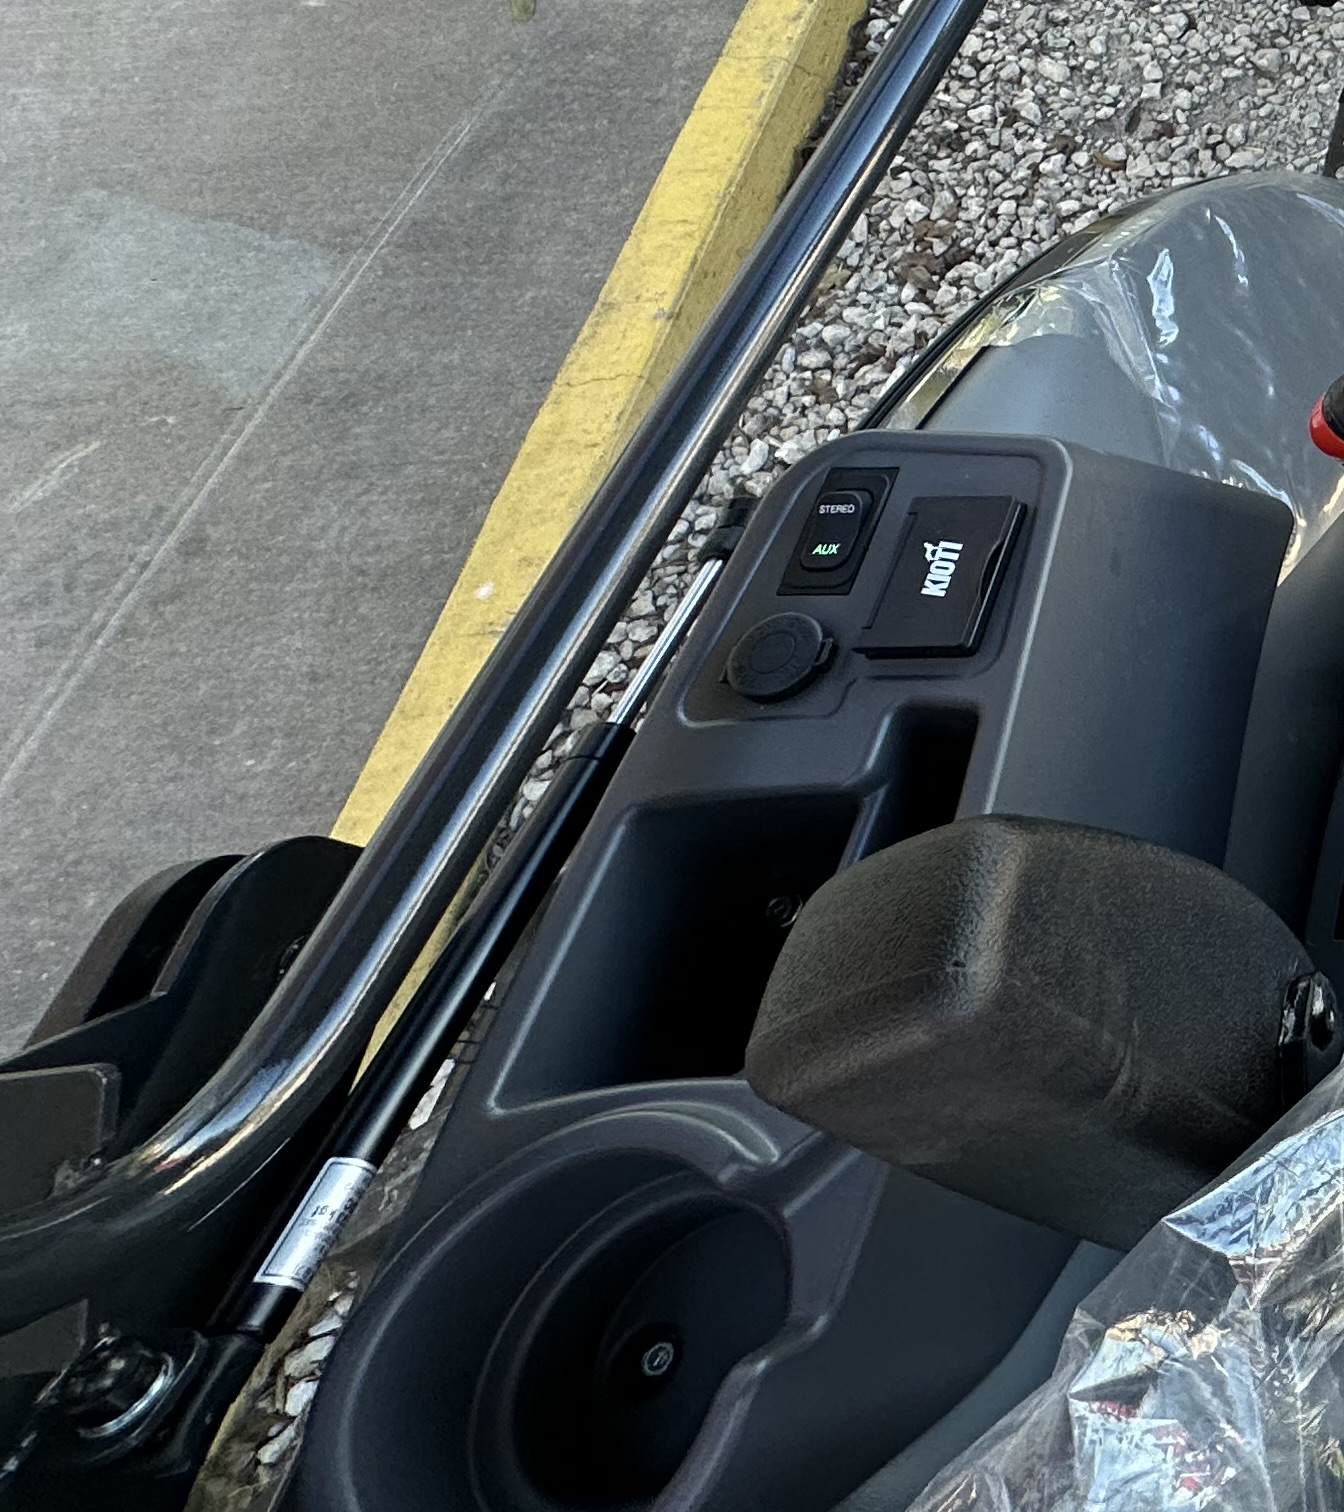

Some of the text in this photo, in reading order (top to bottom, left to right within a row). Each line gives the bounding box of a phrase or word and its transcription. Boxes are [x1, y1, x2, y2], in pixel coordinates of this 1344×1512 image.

[818, 503, 855, 514] STEREO
[812, 543, 841, 556] AUX
[919, 540, 964, 597] KIOTI
